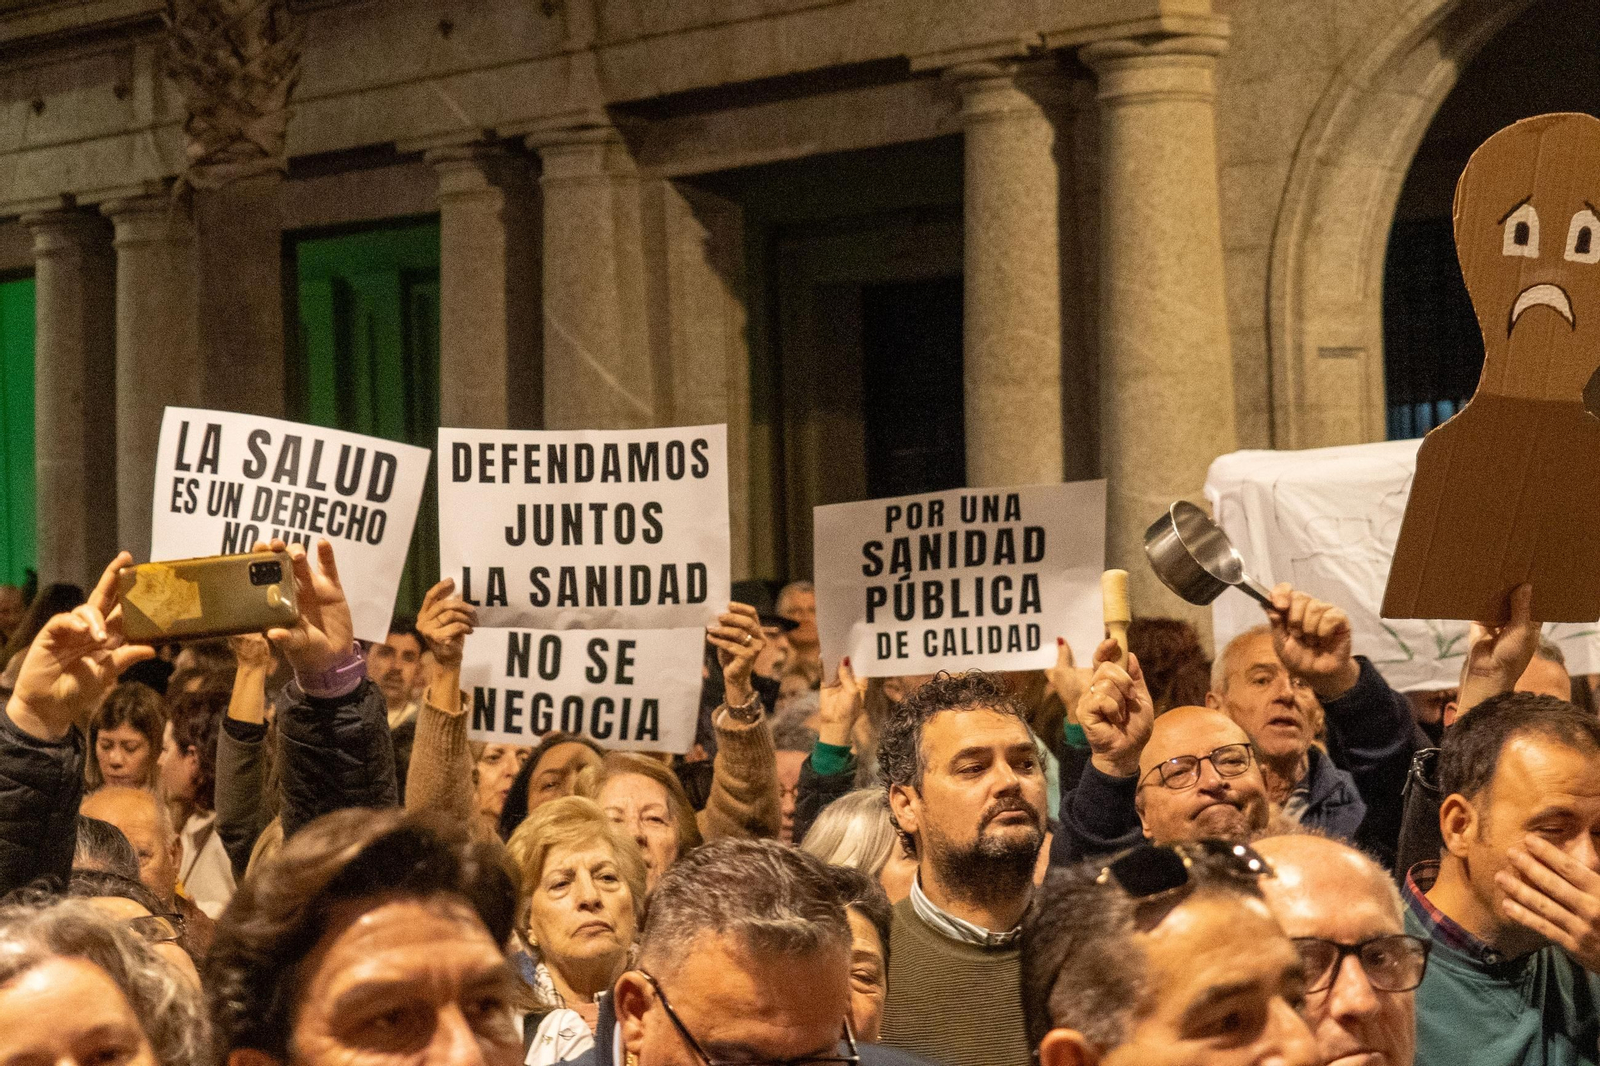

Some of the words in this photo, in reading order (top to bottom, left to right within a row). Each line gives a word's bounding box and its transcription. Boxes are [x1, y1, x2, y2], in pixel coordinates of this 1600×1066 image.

[174, 420, 222, 475] LA
[242, 429, 398, 503] SALUD
[451, 438, 710, 485] DEFENDAMOS
[170, 476, 199, 514] ES
[207, 480, 243, 519] UN
[250, 486, 387, 546] DERECHO
[504, 501, 663, 546] JUNTOS
[885, 499, 945, 533] POR
[960, 493, 1022, 524] UNA
[221, 521, 260, 555] NO
[861, 526, 1046, 577] SANIDAD
[462, 566, 509, 607] LA
[529, 562, 708, 608] SANIDAD
[865, 571, 1042, 624] PÚBLICA
[505, 631, 562, 681] NO
[584, 638, 637, 685] SE
[876, 631, 909, 660] DE
[923, 623, 1041, 657] CALIDAD
[472, 686, 660, 741] NEGOCIA
